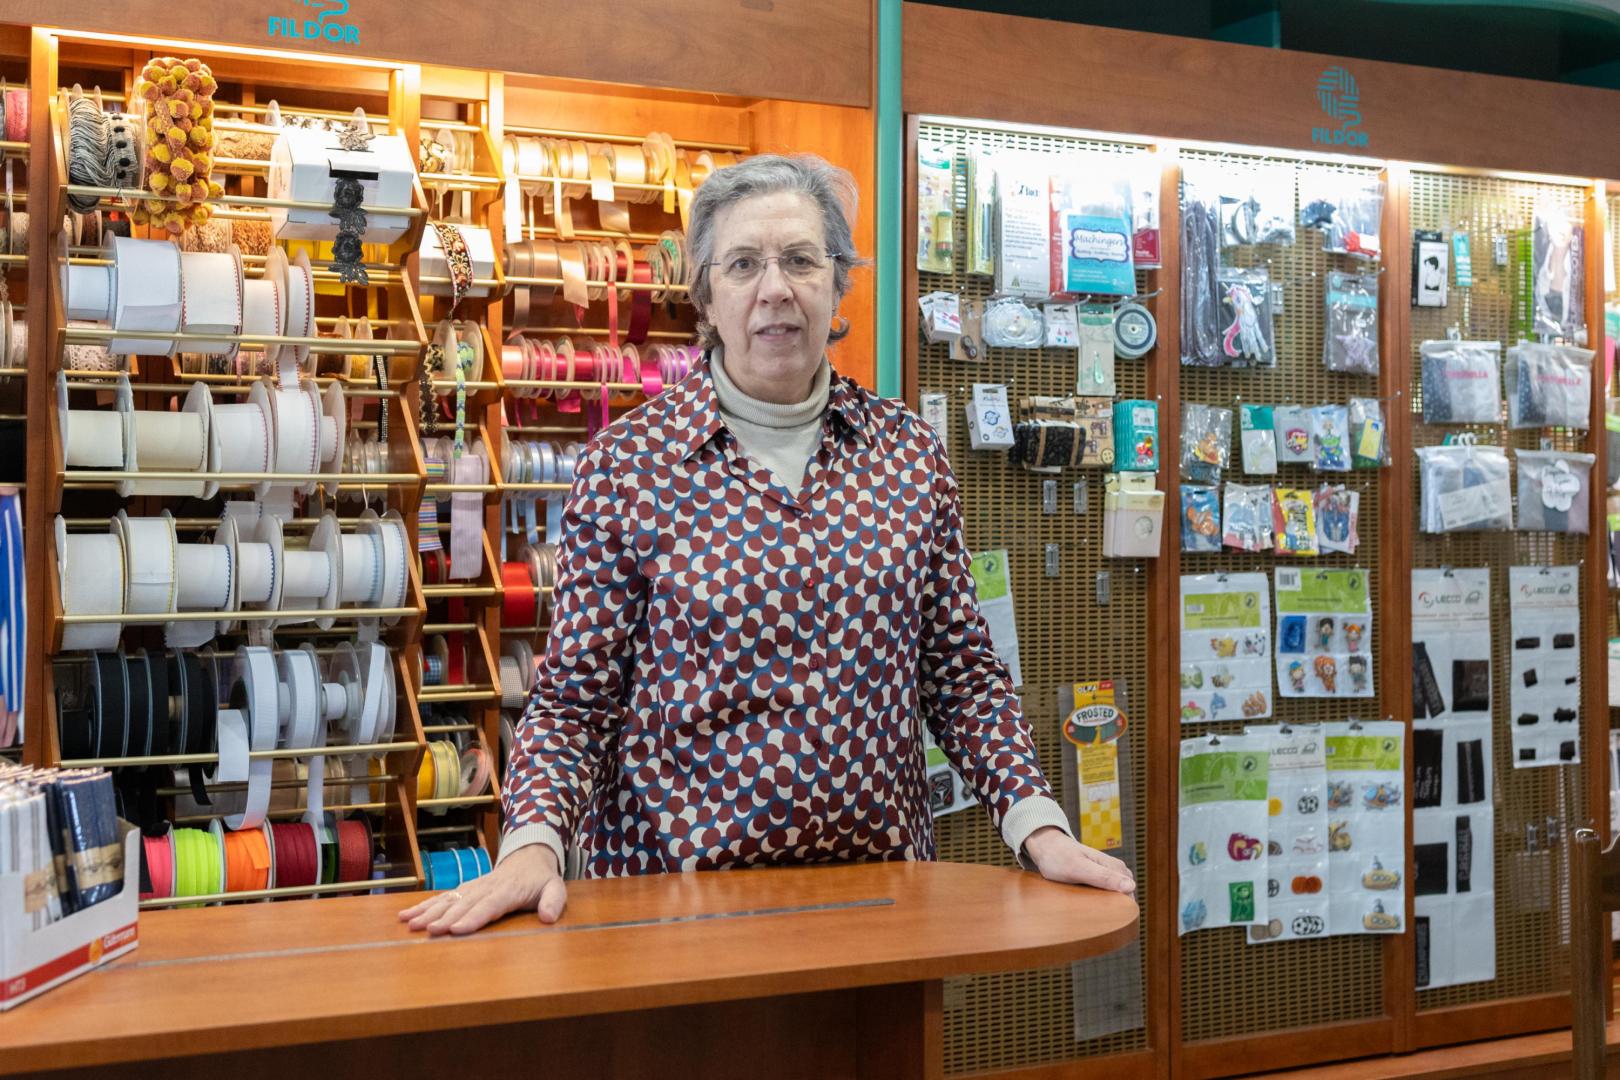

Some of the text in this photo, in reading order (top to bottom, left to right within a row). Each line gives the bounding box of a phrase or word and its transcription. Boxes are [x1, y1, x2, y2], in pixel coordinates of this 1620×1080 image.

[268, 16, 360, 45] FILDOR
[1312, 128, 1369, 147] FILDOR
[1076, 707, 1114, 722] FROSTED
